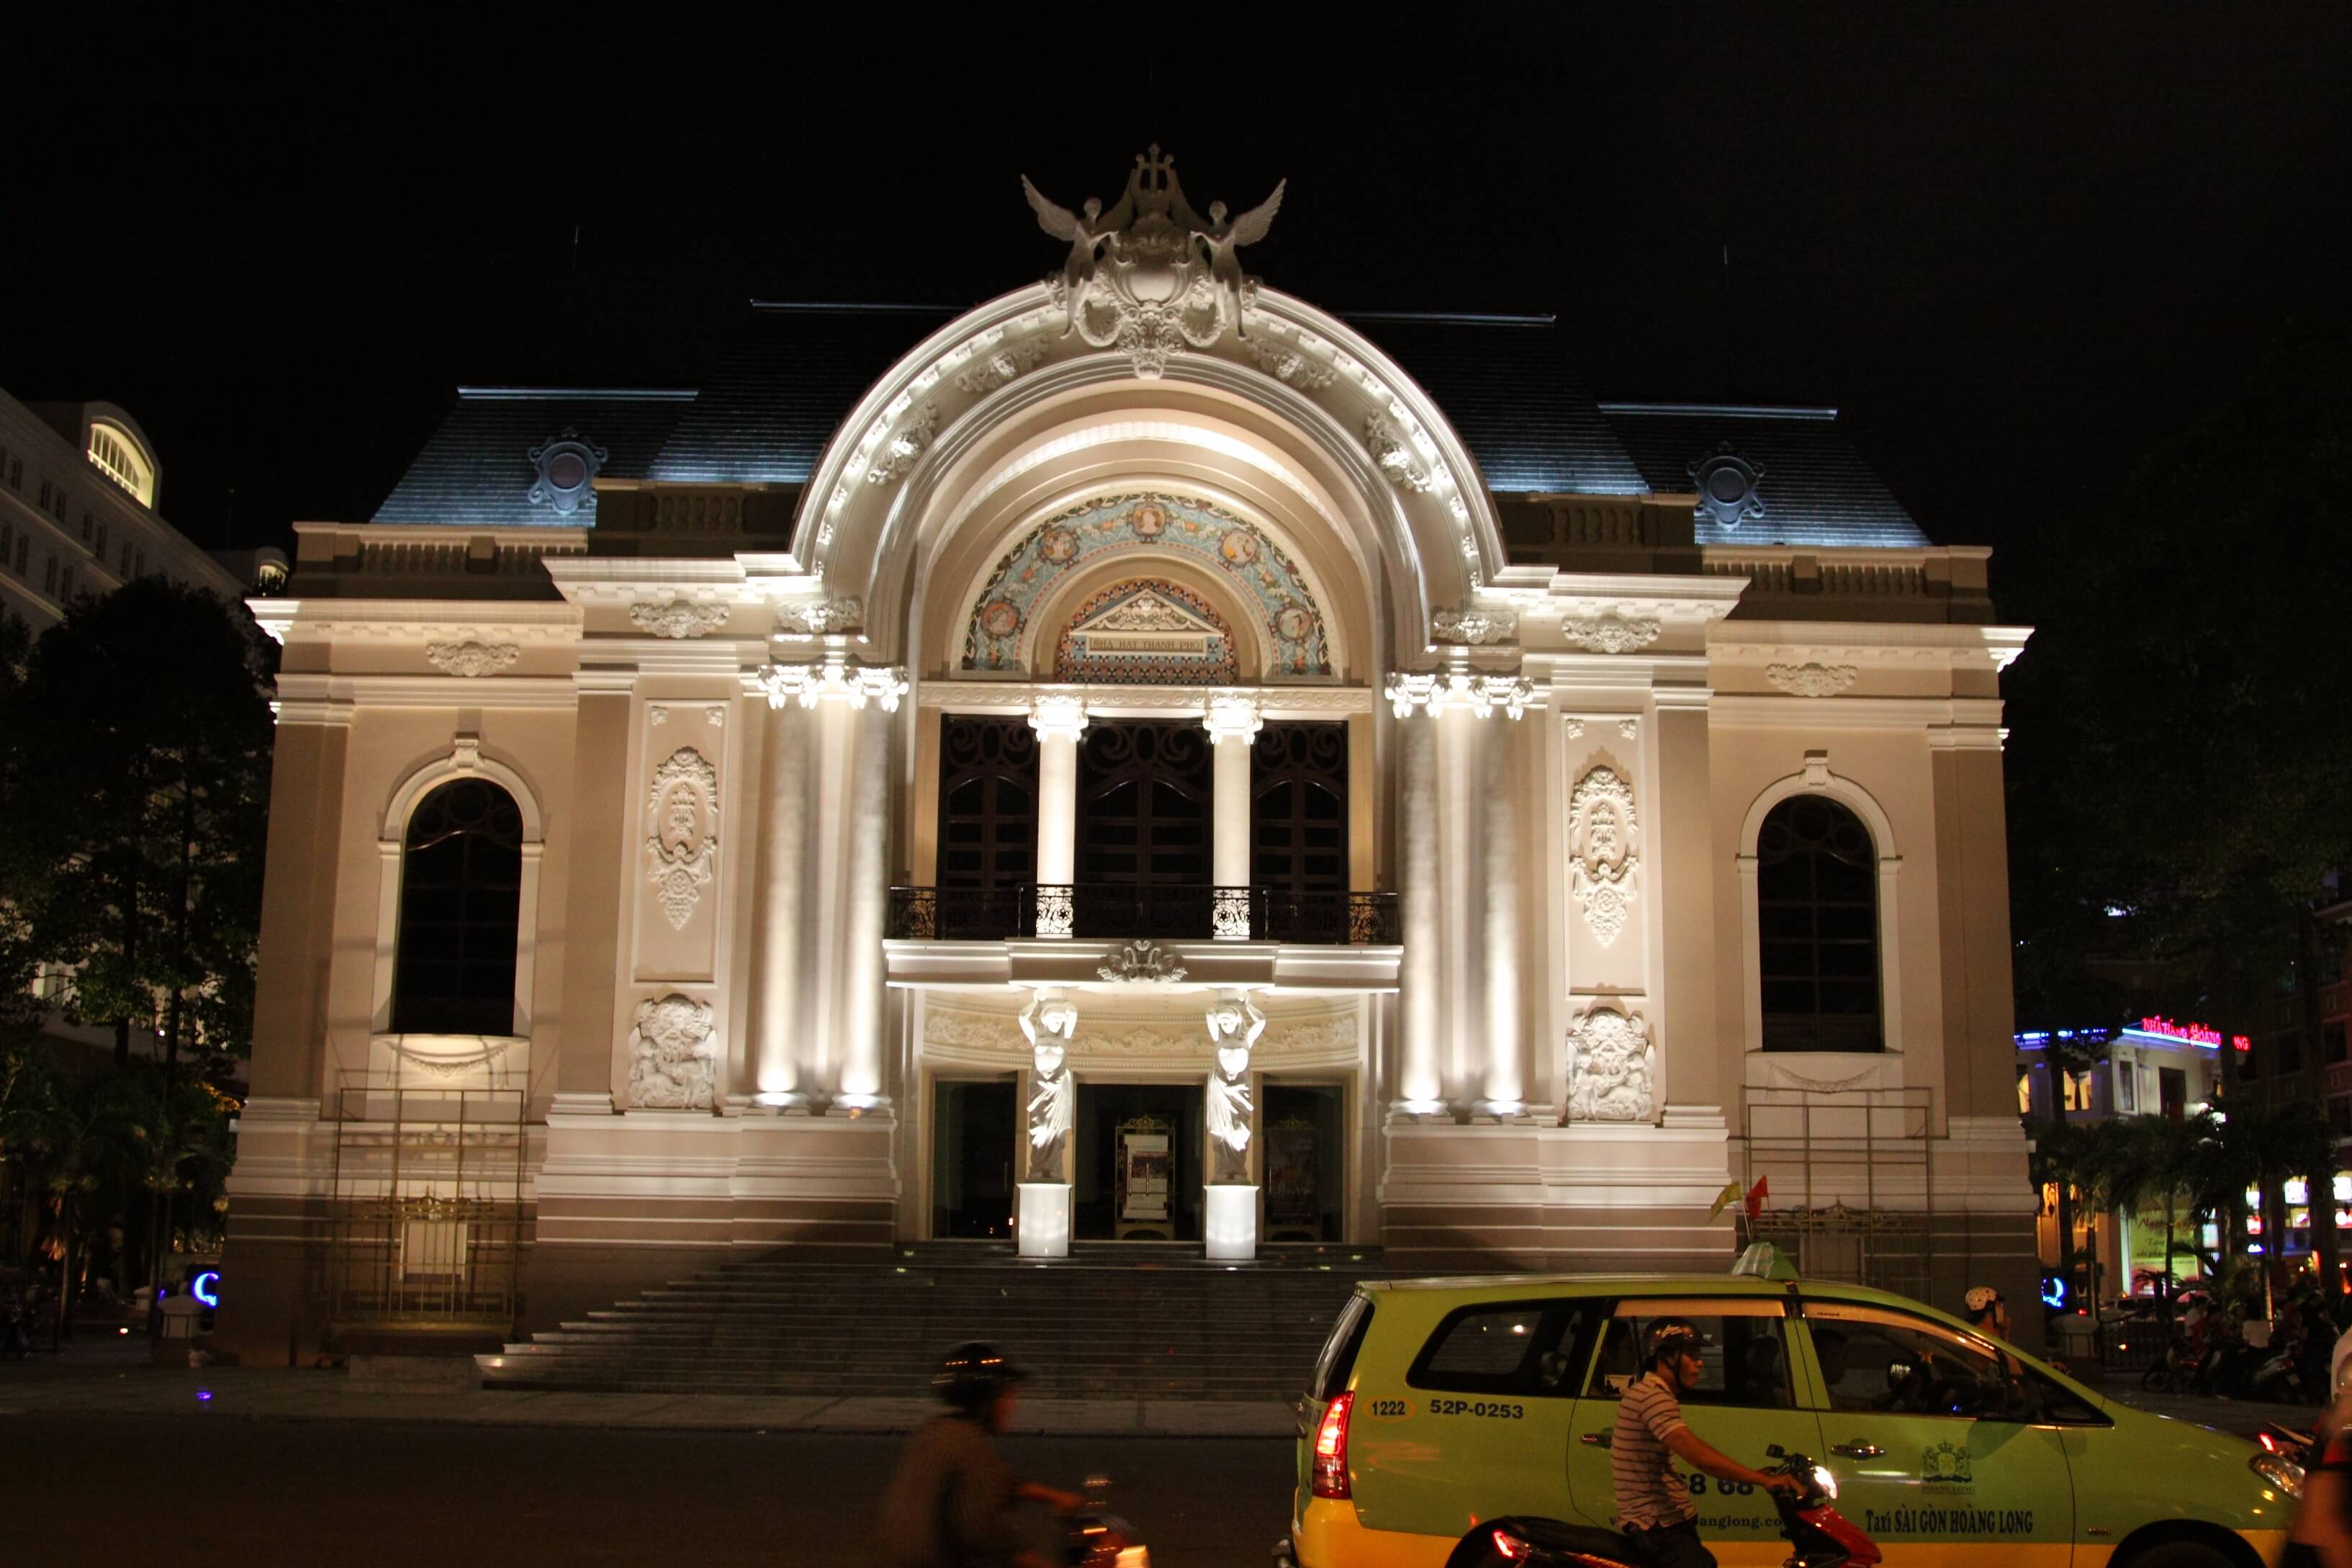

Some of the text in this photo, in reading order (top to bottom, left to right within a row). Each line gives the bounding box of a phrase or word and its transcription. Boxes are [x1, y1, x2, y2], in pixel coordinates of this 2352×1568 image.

[1371, 1400, 1405, 1416] 1222
[1430, 1399, 1524, 1419] 52P-0253
[1865, 1502, 2034, 1533] Taxi SÀI GÒN HOÀNG LONG
